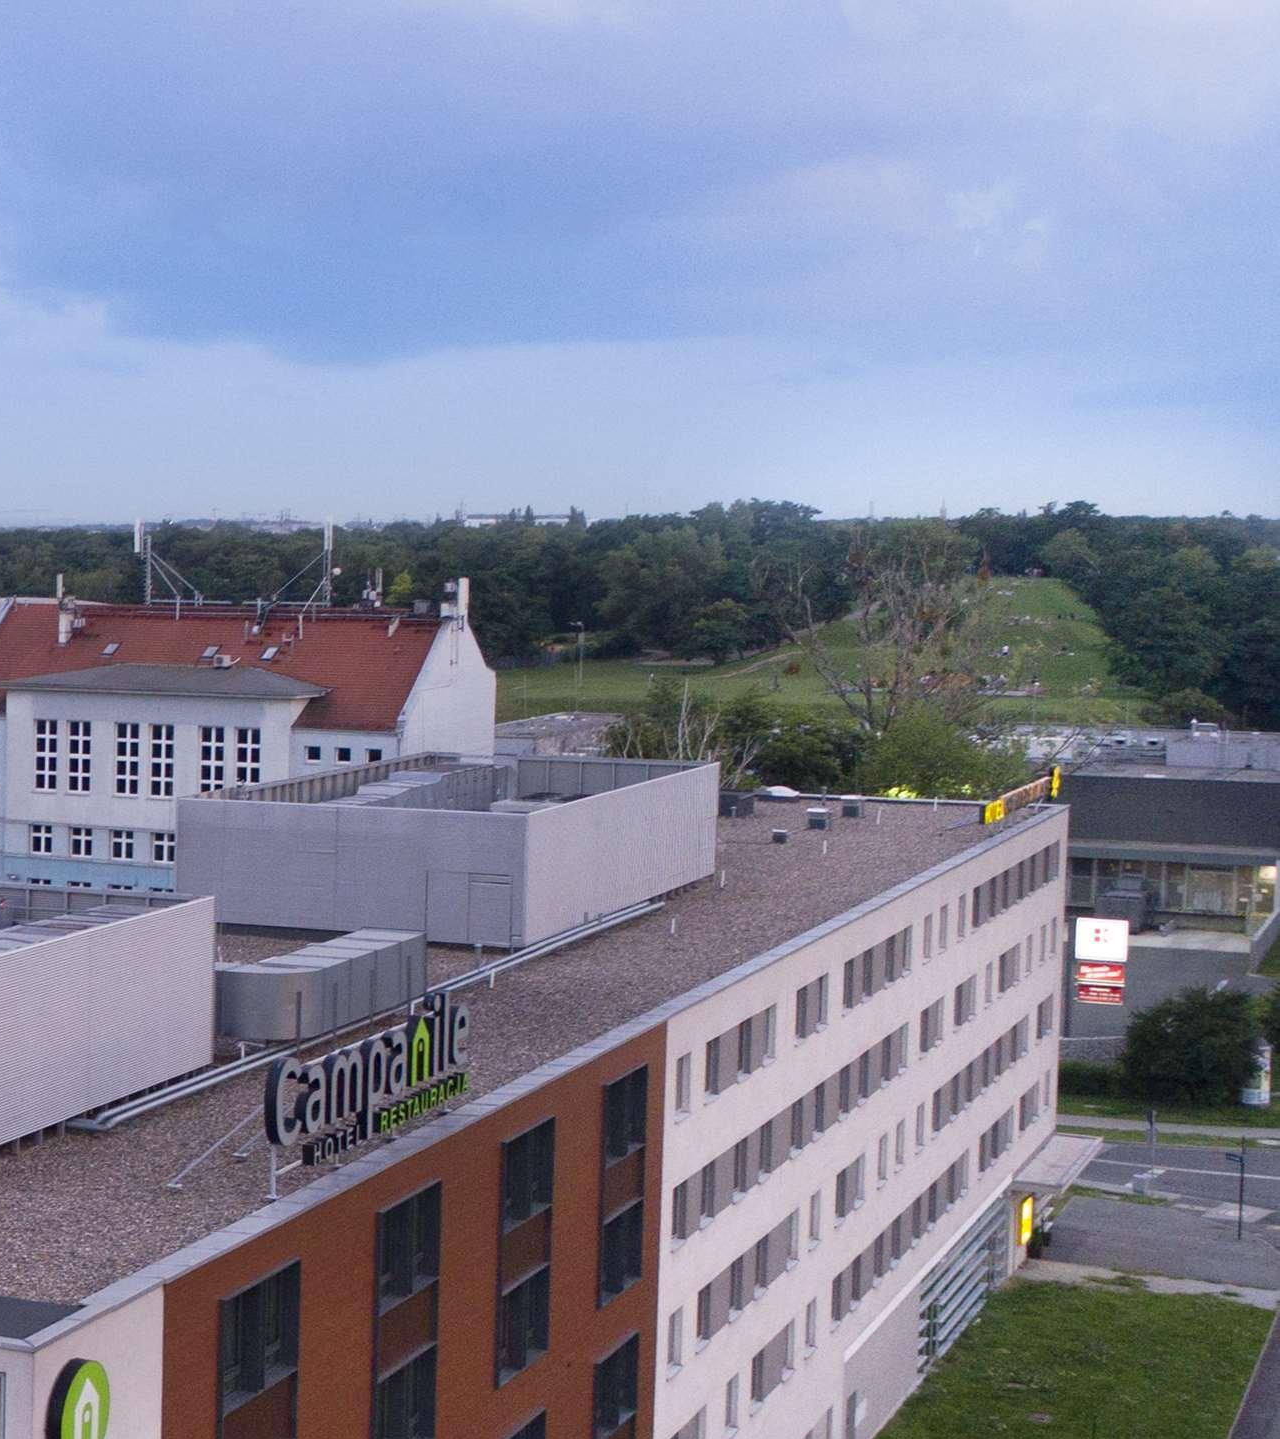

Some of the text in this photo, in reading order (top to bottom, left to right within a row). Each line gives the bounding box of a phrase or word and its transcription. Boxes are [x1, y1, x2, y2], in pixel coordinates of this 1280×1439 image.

[265, 991, 471, 1146] Campanile
[379, 1071, 470, 1134] RESTAURACJA
[309, 1124, 362, 1166] HOTEL
